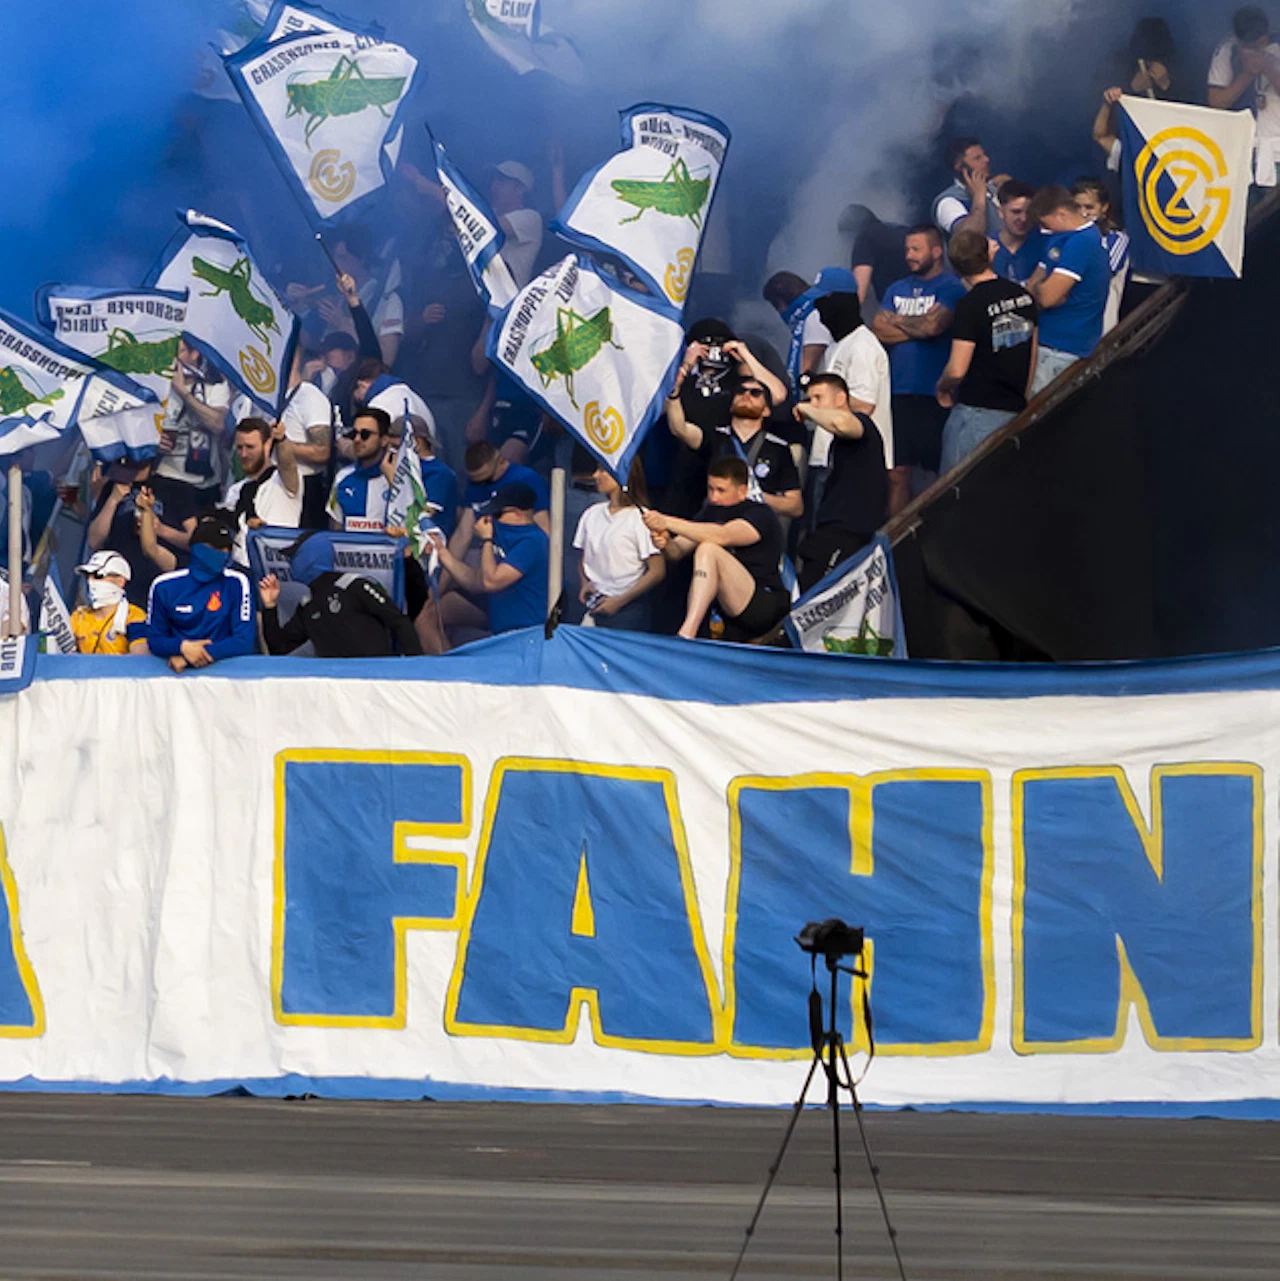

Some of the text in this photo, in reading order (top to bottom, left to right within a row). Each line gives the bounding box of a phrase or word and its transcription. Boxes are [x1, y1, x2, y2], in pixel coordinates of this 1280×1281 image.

[455, 204, 487, 243] CLUB
[502, 286, 549, 357] GRASSHOPPER
[44, 587, 76, 654] GRASSHO
[271, 748, 1280, 1059] FAHN
